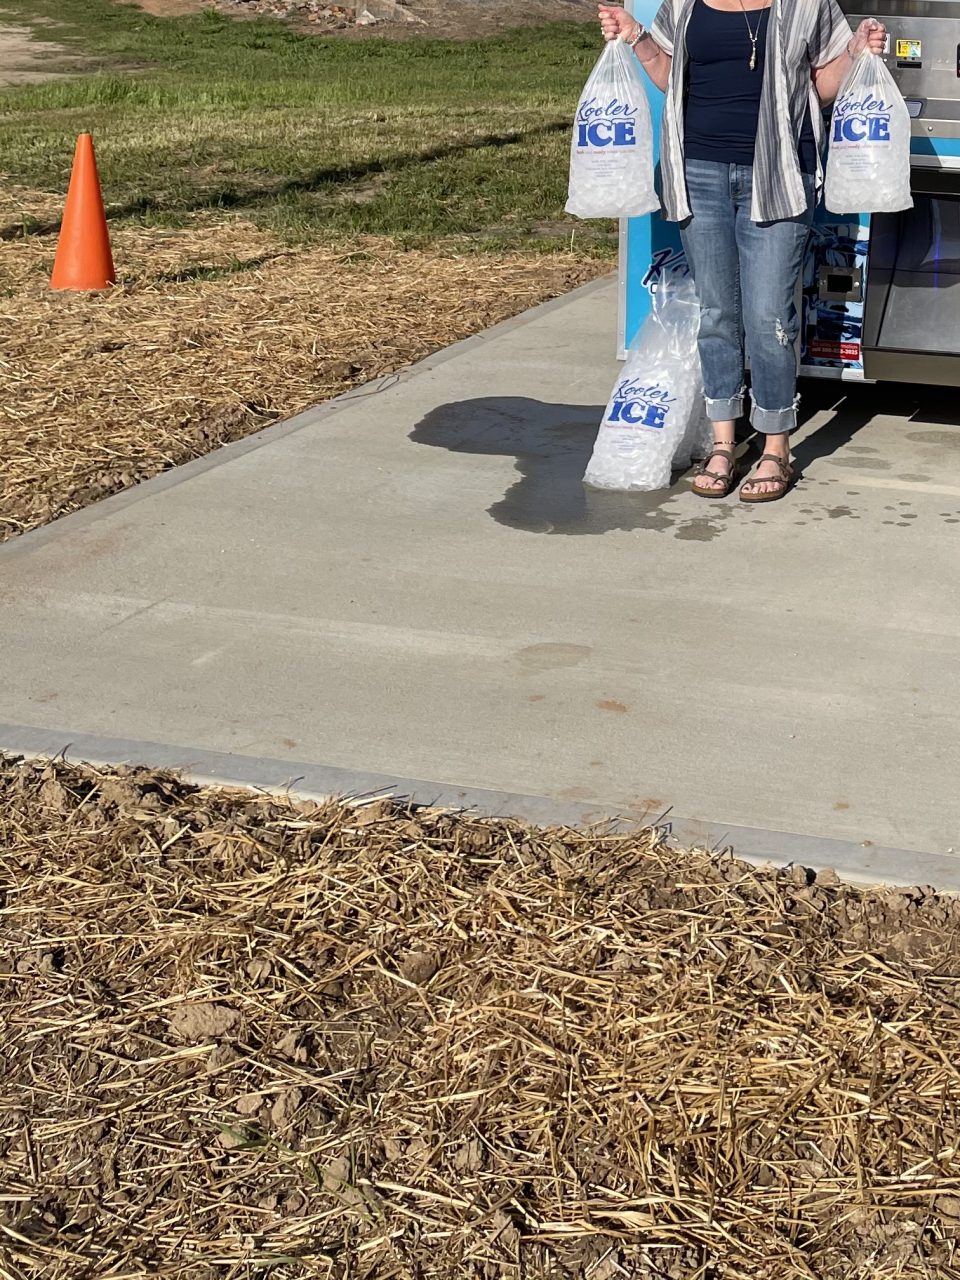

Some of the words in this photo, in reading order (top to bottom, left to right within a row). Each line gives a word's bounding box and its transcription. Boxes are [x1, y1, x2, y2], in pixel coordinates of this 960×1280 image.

[577, 97, 638, 120] Kooler
[833, 92, 893, 117] Kooler
[577, 118, 636, 147] ICE
[833, 113, 890, 142] ICE
[612, 378, 677, 403] Kooler
[607, 397, 670, 428] ICE
